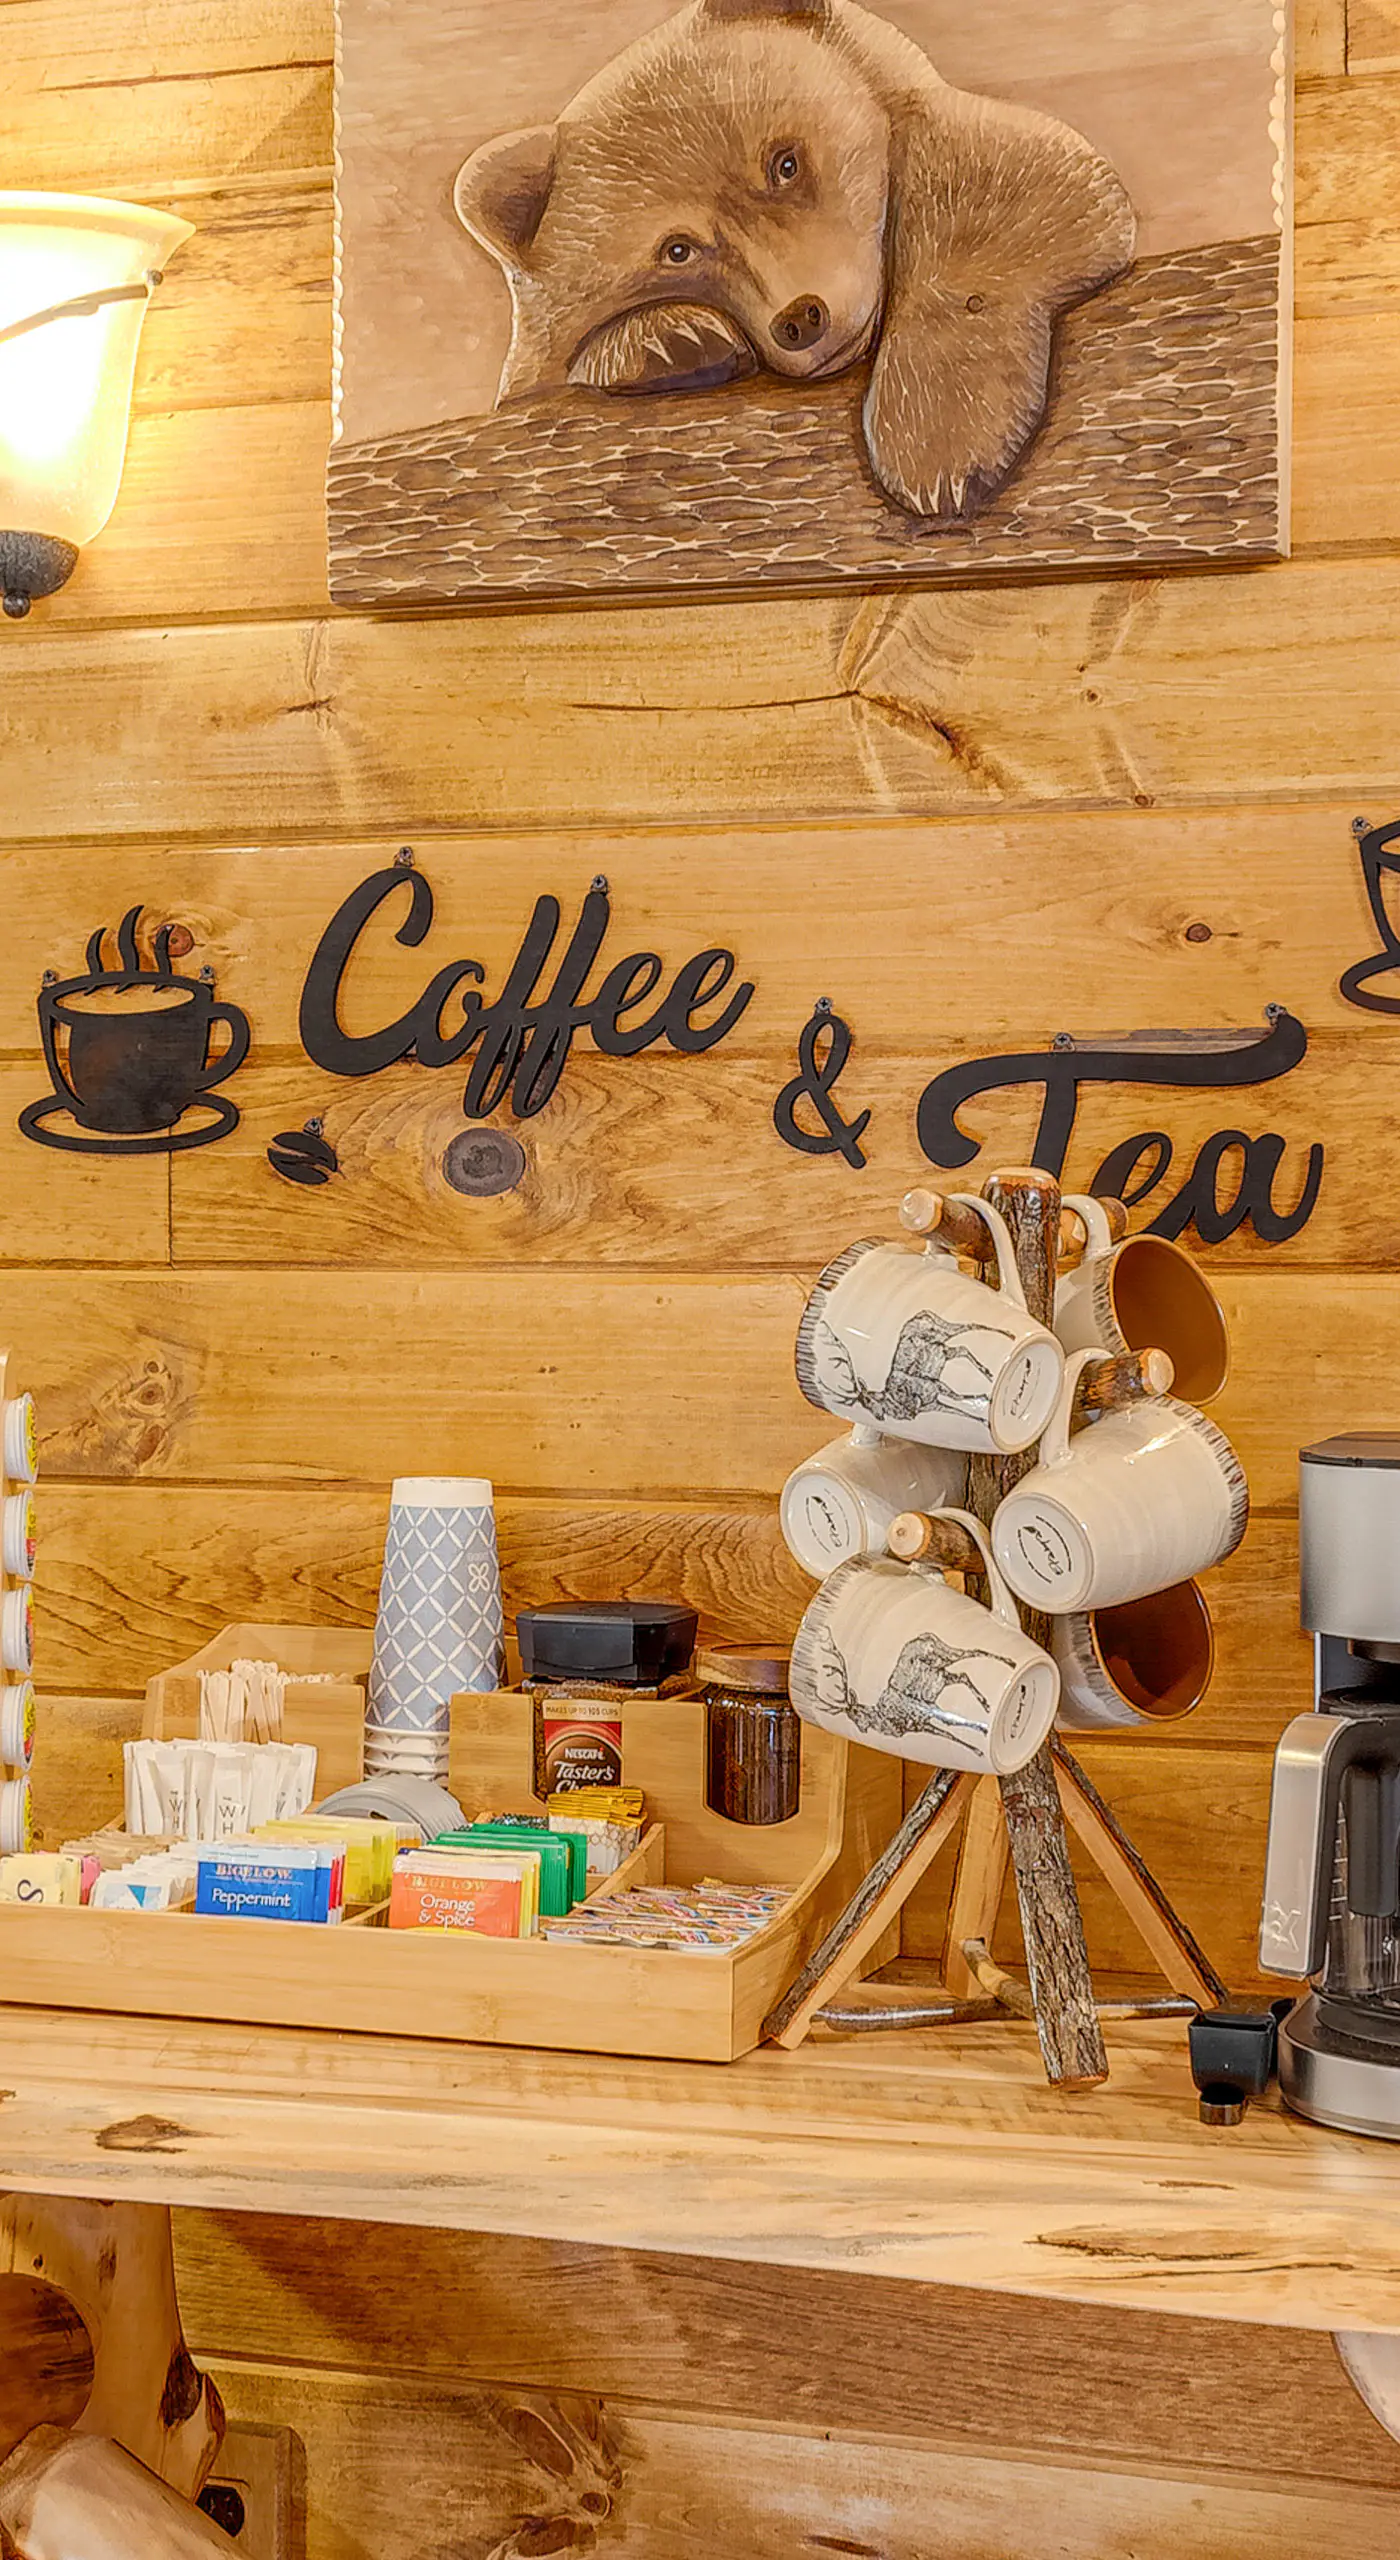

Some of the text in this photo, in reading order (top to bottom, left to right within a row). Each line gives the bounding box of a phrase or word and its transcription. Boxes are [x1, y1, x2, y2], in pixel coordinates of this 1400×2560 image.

[299, 866, 1324, 1244] Coffee & Tea
[553, 1760, 615, 1781] Taster's
[215, 1863, 293, 1880] BIGELOW
[212, 1887, 291, 1912] Peppermint
[419, 1893, 476, 1917] Orange
[417, 1908, 476, 1932] & Spice
